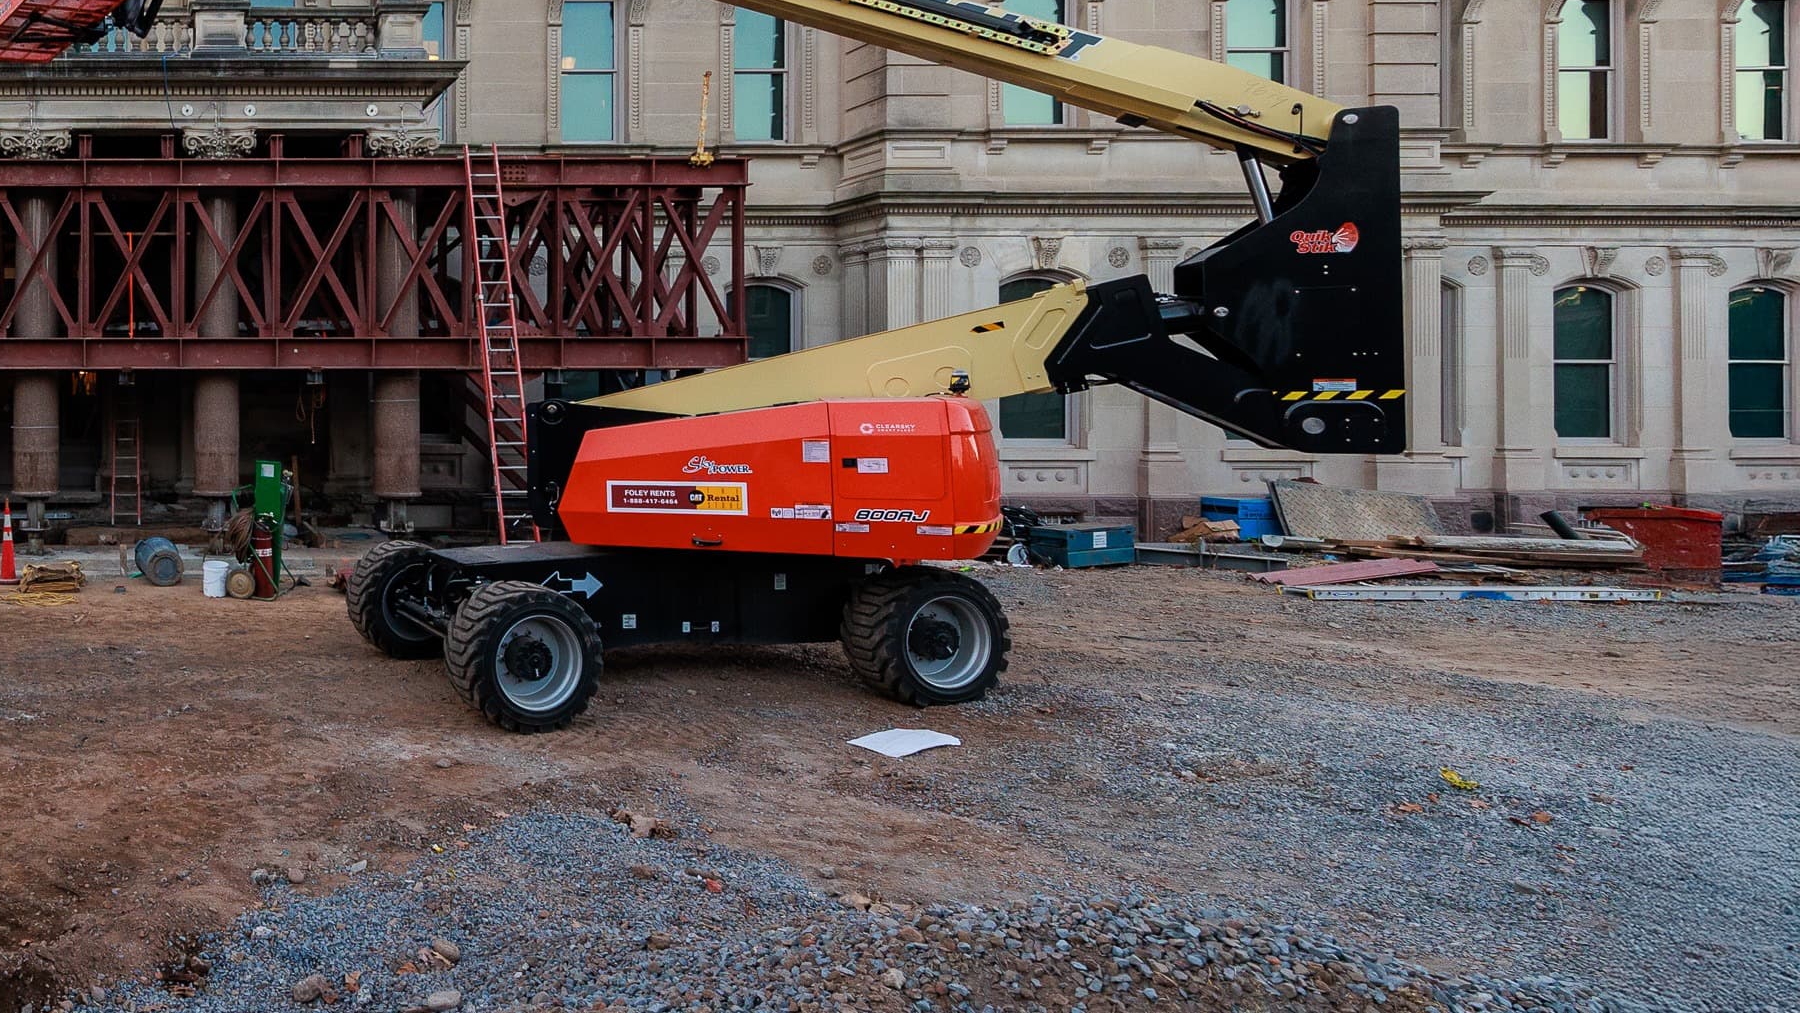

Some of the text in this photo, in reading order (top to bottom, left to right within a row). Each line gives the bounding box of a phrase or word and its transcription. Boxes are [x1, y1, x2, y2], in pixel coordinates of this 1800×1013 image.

[1290, 230, 1332, 244] Quik
[1296, 242, 1336, 253] Stik
[624, 489, 649, 497] FOLEY
[689, 493, 702, 501] CAT
[707, 494, 740, 502] Rental
[855, 510, 929, 522] 800AJ
